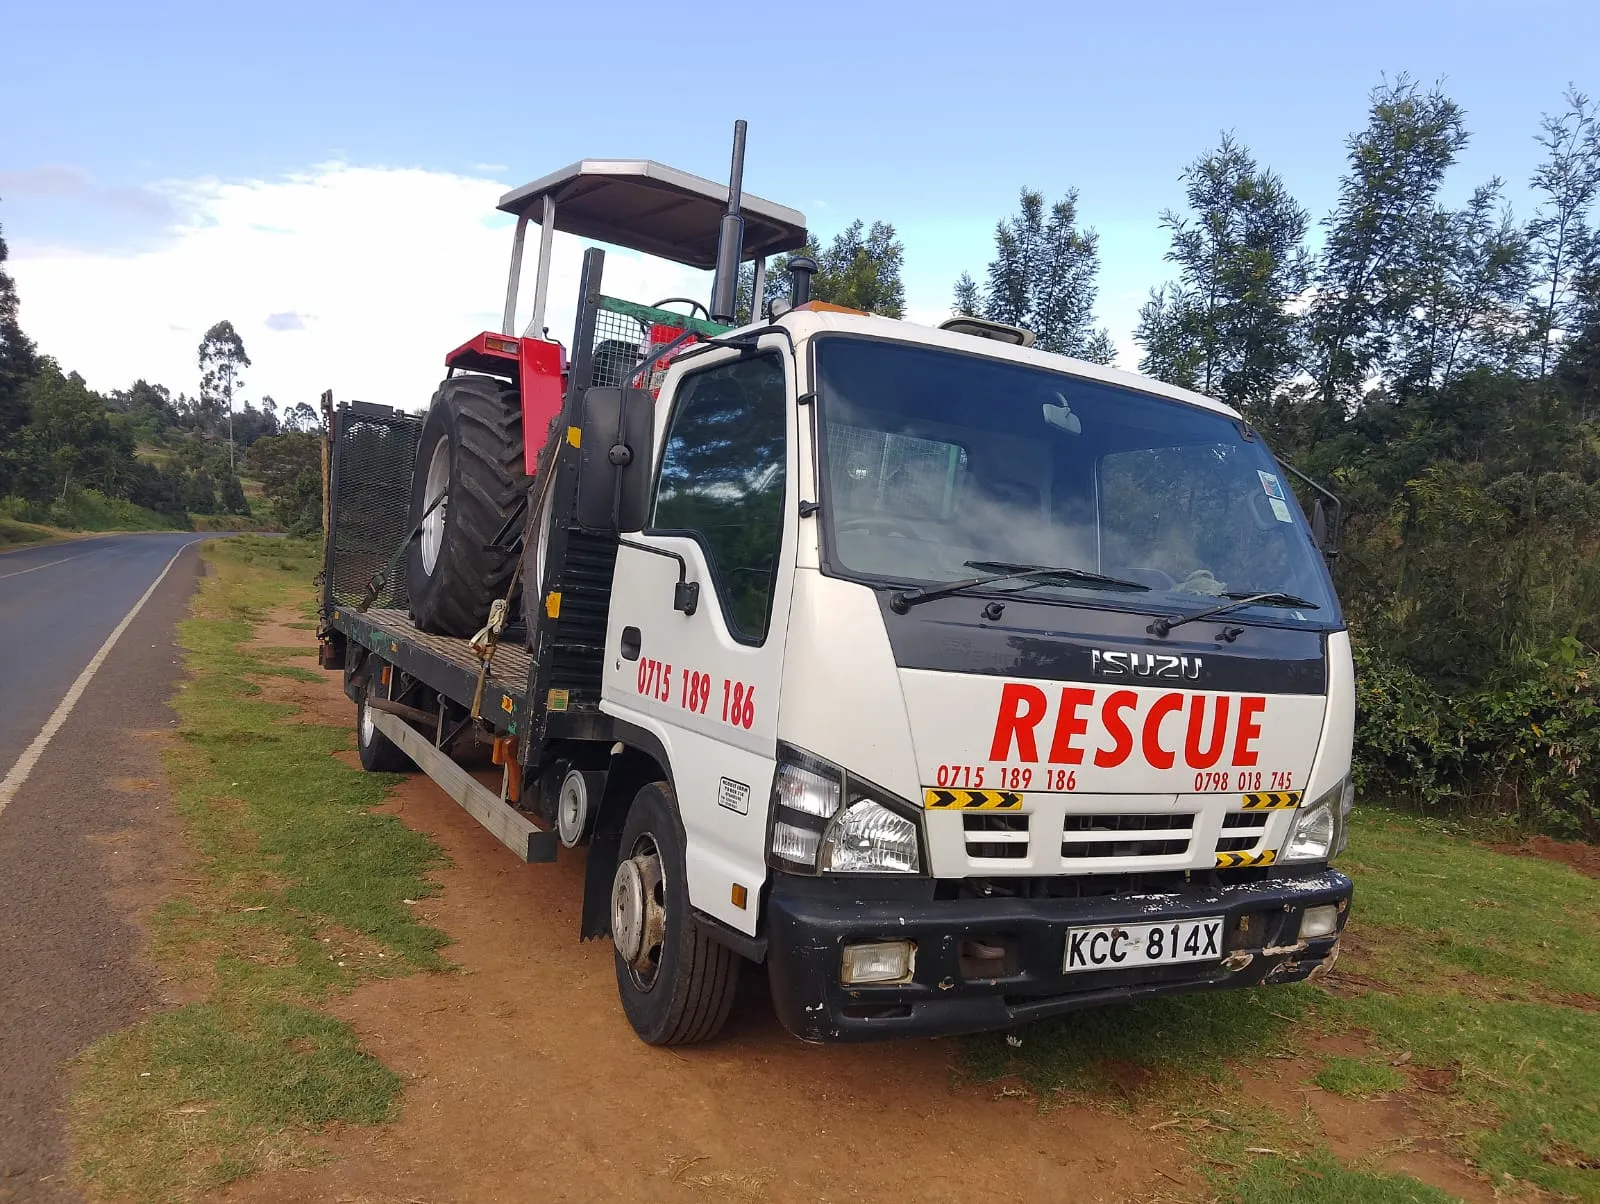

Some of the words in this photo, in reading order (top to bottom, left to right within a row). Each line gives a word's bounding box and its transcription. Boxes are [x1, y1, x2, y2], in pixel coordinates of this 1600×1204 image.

[1092, 649, 1202, 679] ISUZU
[637, 657, 672, 702] 0715
[682, 669, 711, 714] 189
[722, 679, 755, 730] 186
[989, 682, 1266, 770] RESCUE
[937, 765, 984, 788] 0715
[1001, 767, 1032, 789] 189
[1046, 769, 1076, 791] 186
[1194, 771, 1229, 791] 0798
[1237, 771, 1262, 791] 018
[1271, 772, 1292, 790] 745
[1069, 930, 1129, 967] KCC
[1146, 923, 1220, 960] 814X
